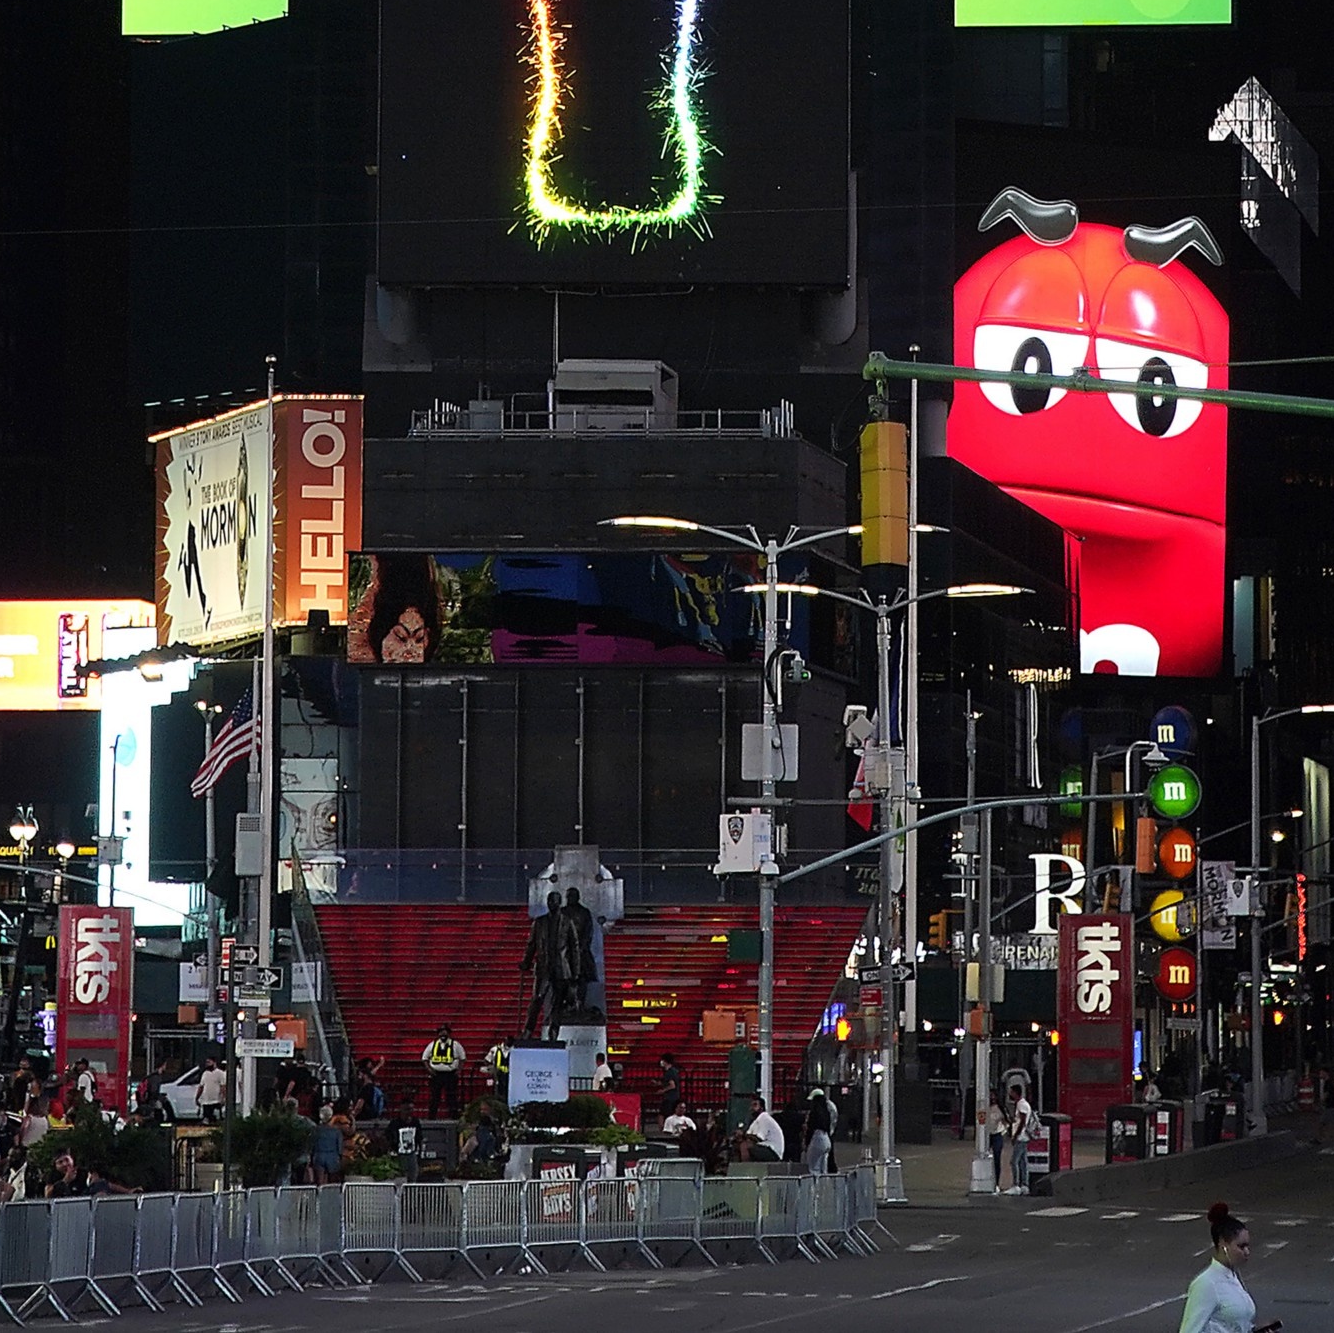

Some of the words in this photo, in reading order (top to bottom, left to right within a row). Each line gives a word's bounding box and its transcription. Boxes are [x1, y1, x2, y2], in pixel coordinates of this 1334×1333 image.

[212, 480, 228, 504] BOOK
[228, 476, 237, 499] OF
[300, 409, 346, 613] HELLO!
[61, 631, 78, 690] TRULY
[1157, 724, 1175, 743] m
[1164, 782, 1187, 800] m
[1174, 844, 1193, 863] m
[1029, 853, 1087, 935] R
[75, 914, 120, 1005] tkts
[1076, 921, 1121, 1014] tkts
[1169, 965, 1191, 985] m
